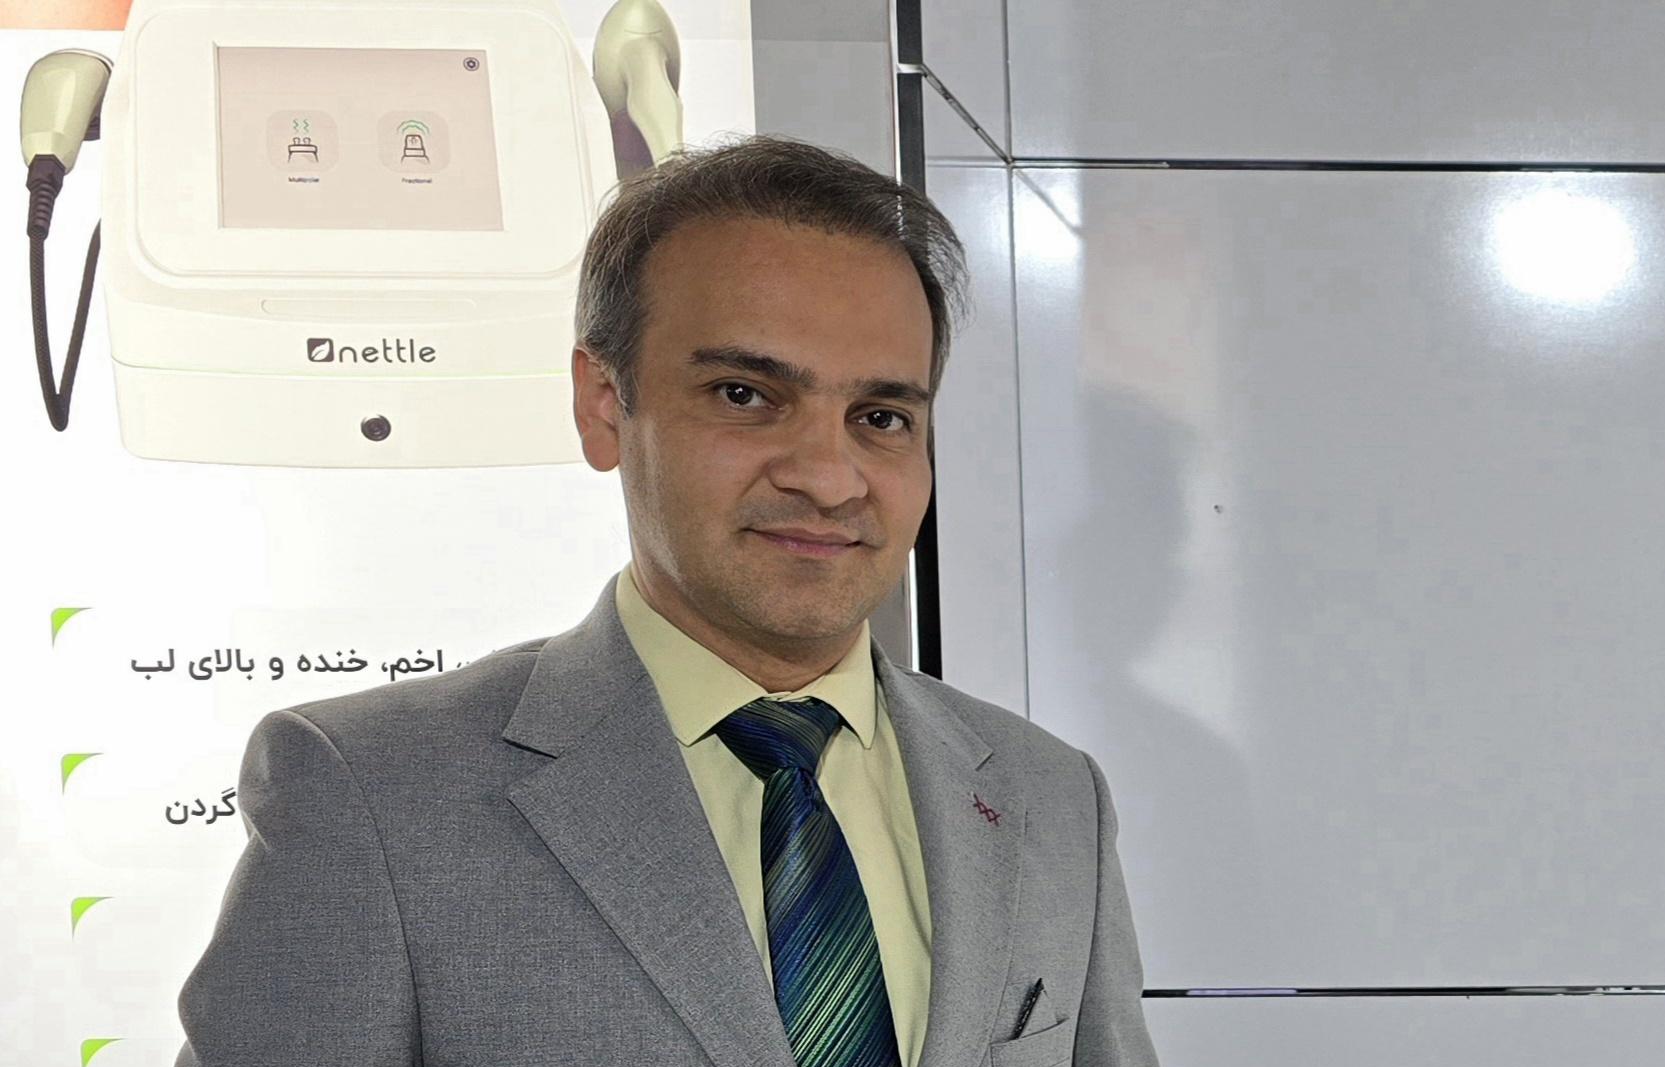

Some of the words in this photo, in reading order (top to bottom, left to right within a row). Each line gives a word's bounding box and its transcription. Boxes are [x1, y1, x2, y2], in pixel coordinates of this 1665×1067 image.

[338, 338, 436, 363] nettle
[131, 649, 175, 680] لب
[189, 649, 255, 680] بالای
[269, 656, 284, 680] و
[297, 649, 368, 672] خنده
[166, 787, 236, 825] گردن
